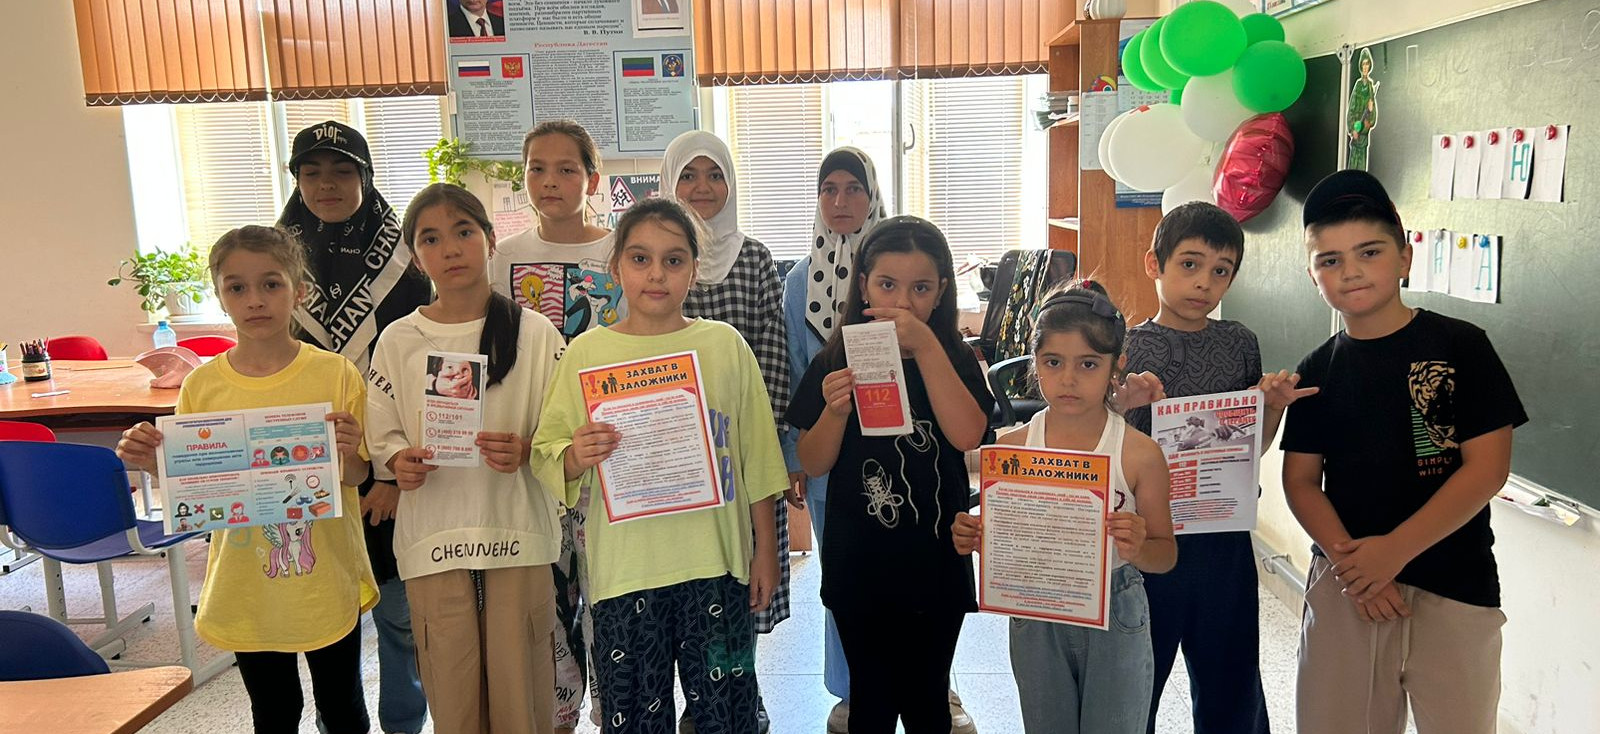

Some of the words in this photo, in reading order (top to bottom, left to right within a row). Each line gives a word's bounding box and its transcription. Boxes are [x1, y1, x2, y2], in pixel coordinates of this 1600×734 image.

[626, 364, 669, 380] ЗАХВАТ
[671, 363, 678, 371] В
[619, 372, 688, 391] ЗАЛОЖНИКИ
[865, 388, 890, 402] 112
[1157, 403, 1180, 416] КАК
[1183, 395, 1257, 413] ПРАВИЛЬНО
[186, 442, 229, 452] ПРАВИЛА
[1031, 456, 1078, 469] ЗАХВАТ
[1083, 460, 1091, 469] В
[1021, 468, 1100, 482] ЗАЛОЖНИКИ
